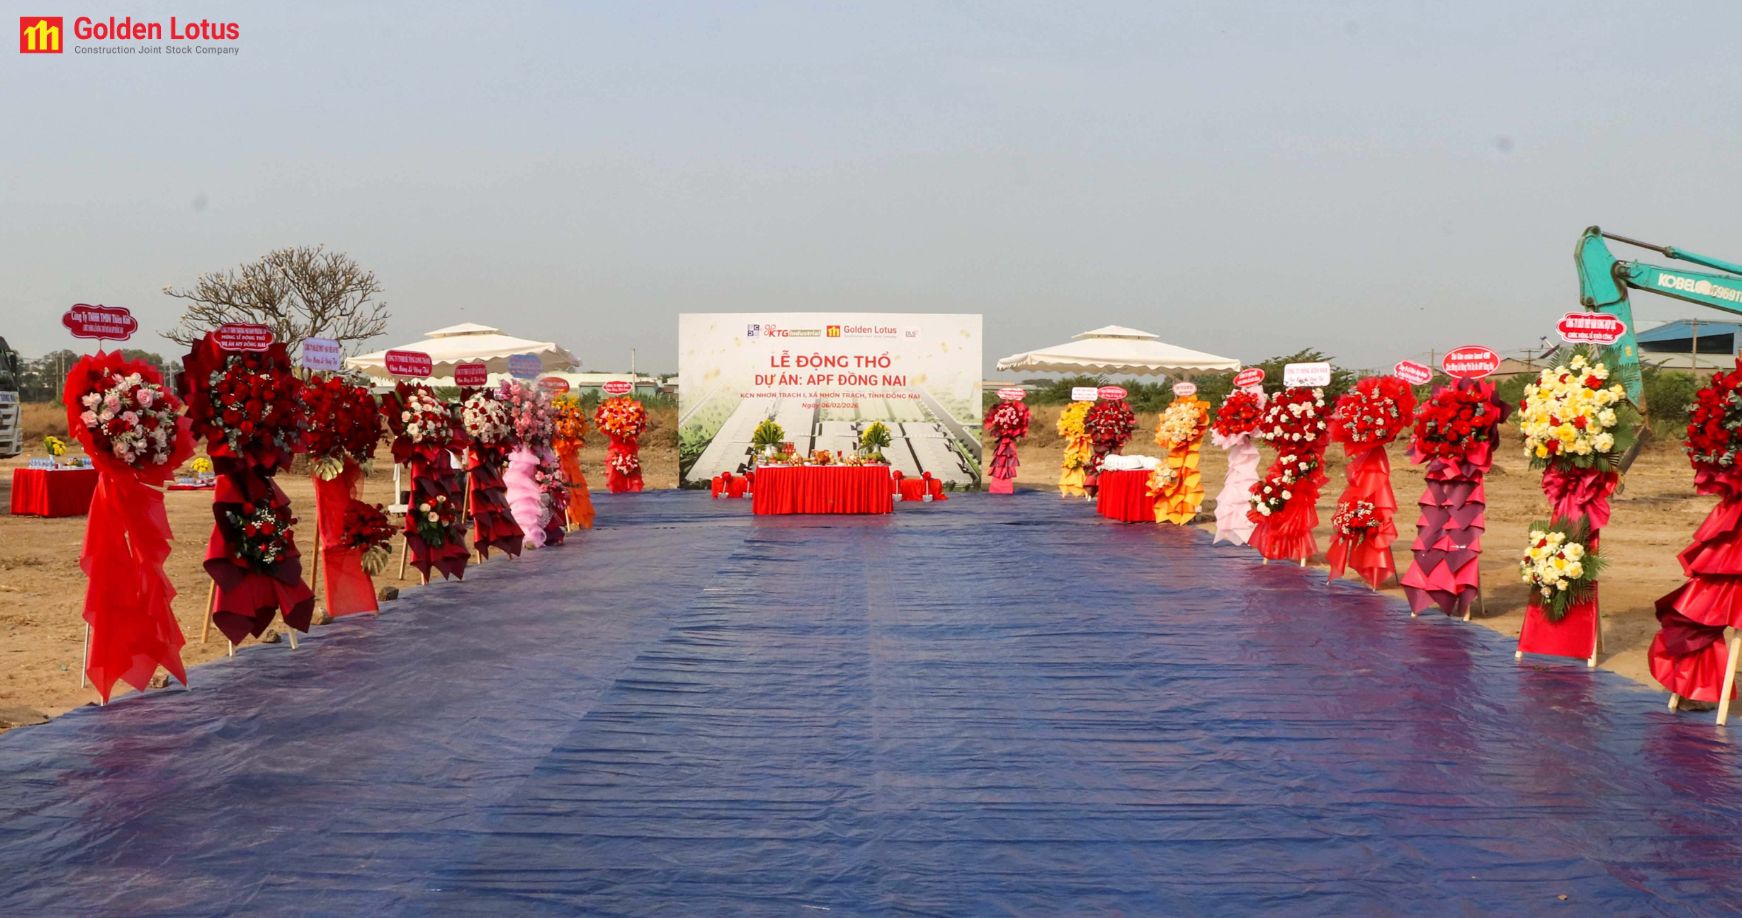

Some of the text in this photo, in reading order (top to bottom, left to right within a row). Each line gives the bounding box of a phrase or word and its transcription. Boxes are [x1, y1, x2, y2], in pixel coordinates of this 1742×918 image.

[768, 329, 789, 338] KTG
[843, 325, 873, 334] Golden
[874, 325, 897, 334] Lotus
[771, 350, 891, 371] LỄ ĐỘNG THỔ
[755, 371, 907, 389] DỰ ÁN: APF ĐỒNG NAI
